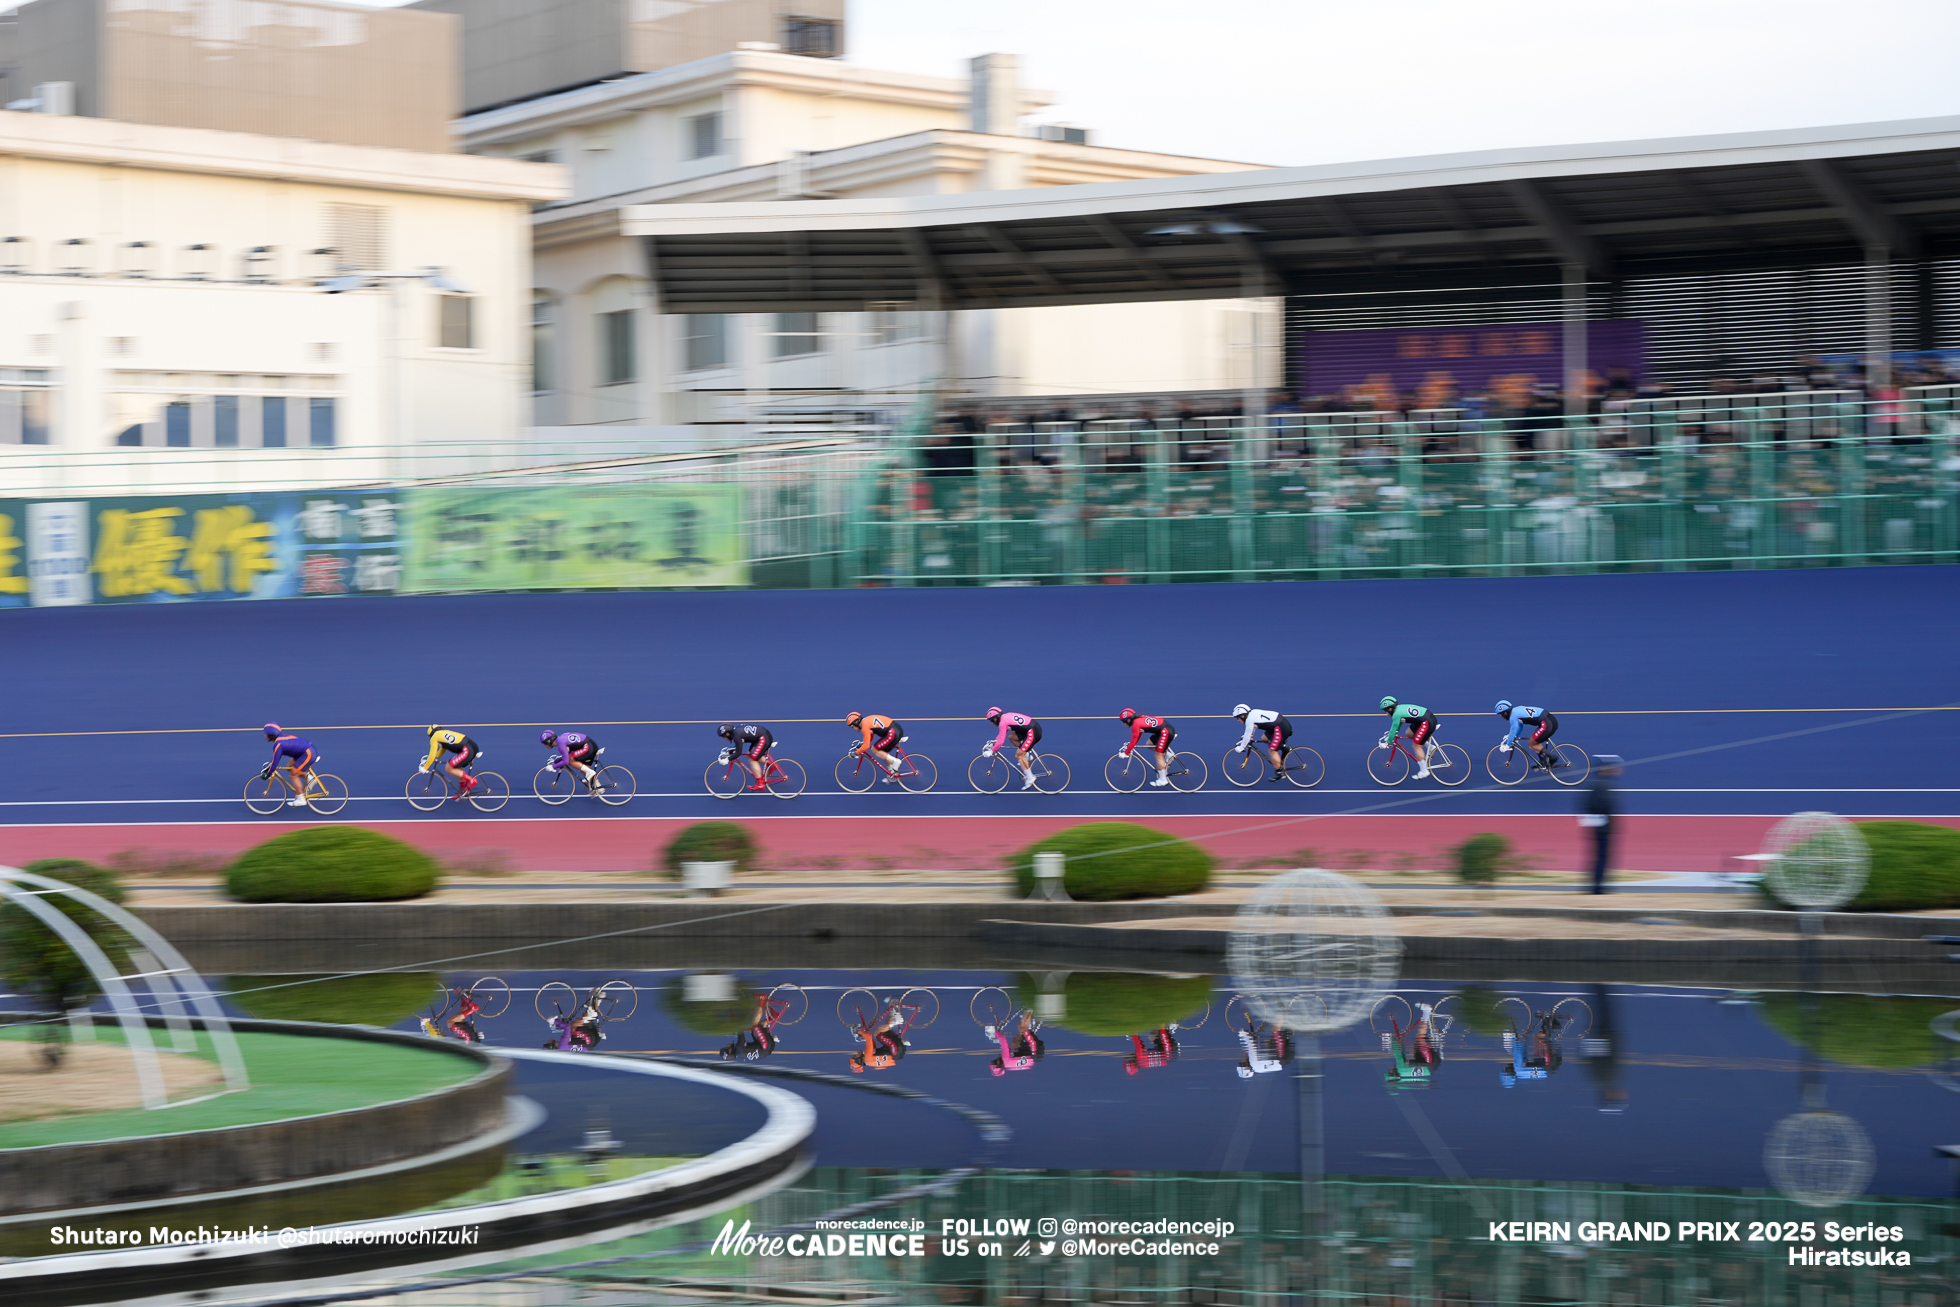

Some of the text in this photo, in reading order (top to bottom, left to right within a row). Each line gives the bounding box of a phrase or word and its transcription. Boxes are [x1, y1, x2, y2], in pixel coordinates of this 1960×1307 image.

[1260, 713, 1271, 722] 1
[1407, 706, 1420, 719] 6
[1526, 706, 1539, 718] 4
[873, 717, 885, 729] 7
[1012, 715, 1025, 726] 8
[1145, 717, 1158, 728] 3
[744, 724, 758, 736] 2
[443, 732, 456, 745] 5
[568, 733, 581, 743] 9
